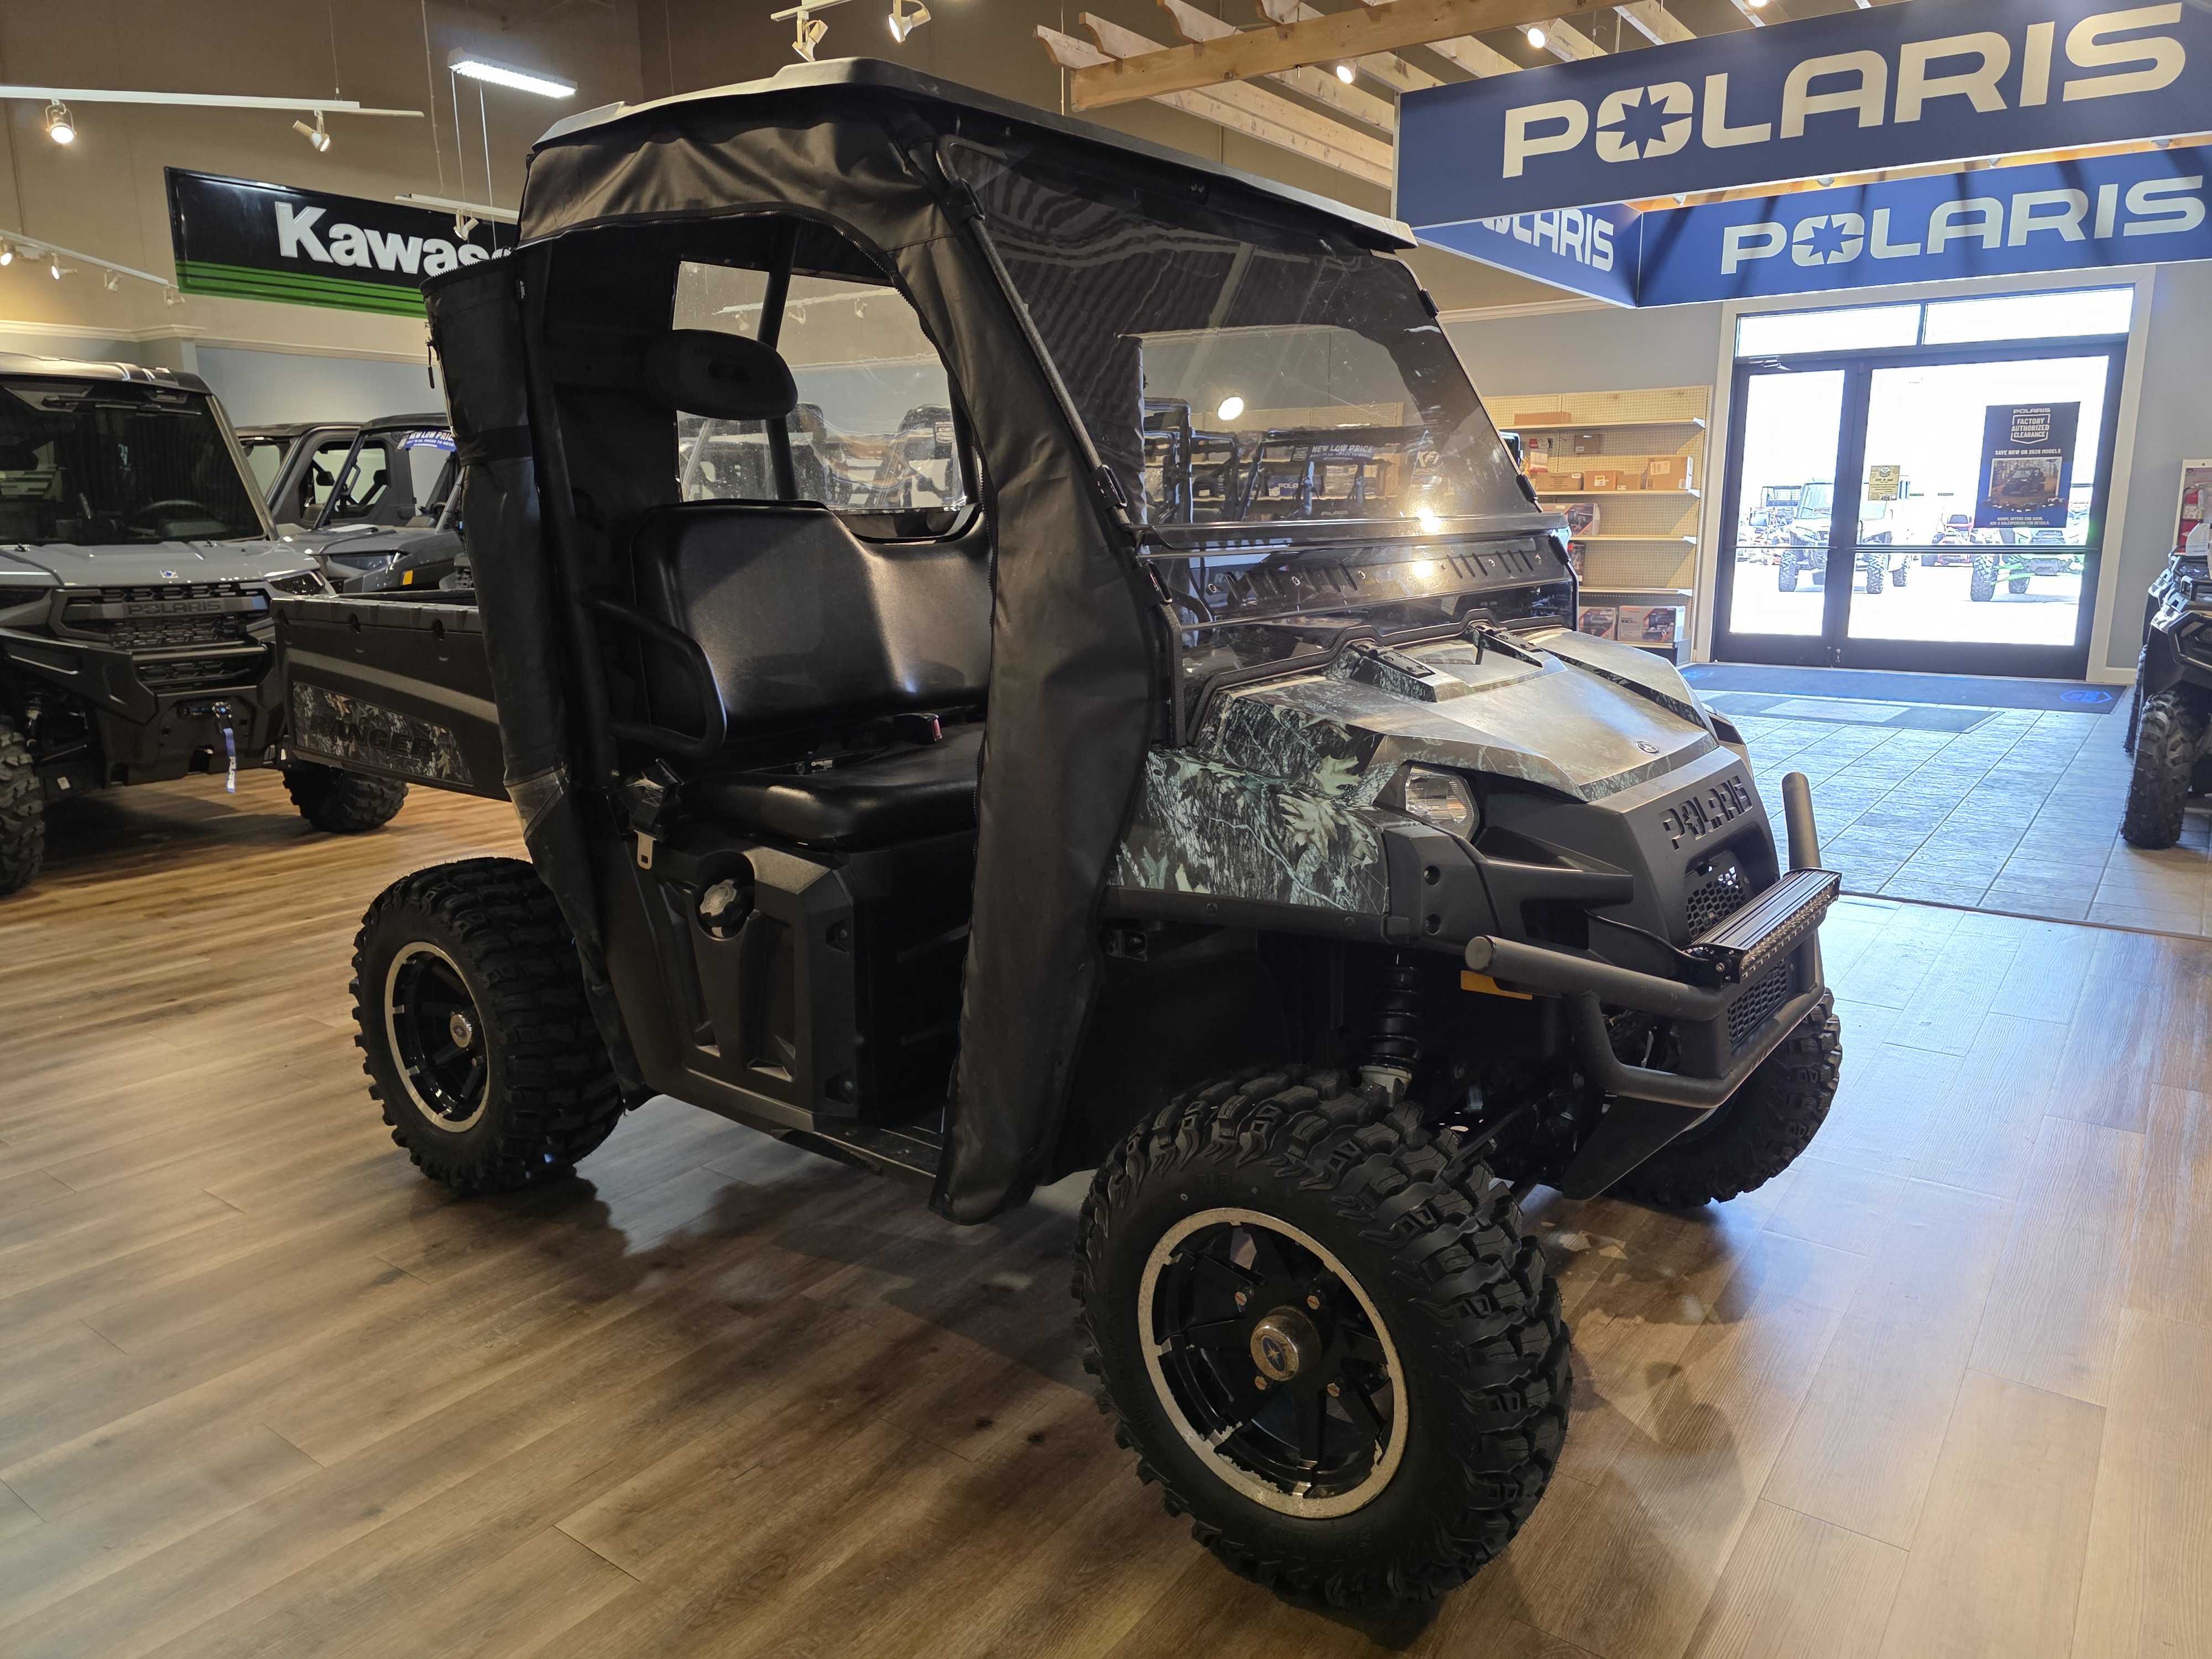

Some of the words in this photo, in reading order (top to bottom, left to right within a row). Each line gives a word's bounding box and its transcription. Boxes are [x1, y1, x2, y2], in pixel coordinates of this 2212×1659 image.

[1503, 2, 2185, 178] POLARIS
[275, 201, 512, 276] Kawas
[1721, 176, 2205, 274] POLARIS
[436, 431, 453, 441] PRIC
[128, 601, 221, 615] POLARIS
[310, 716, 435, 758] RANGER
[1658, 775, 1753, 851] POLARIS
